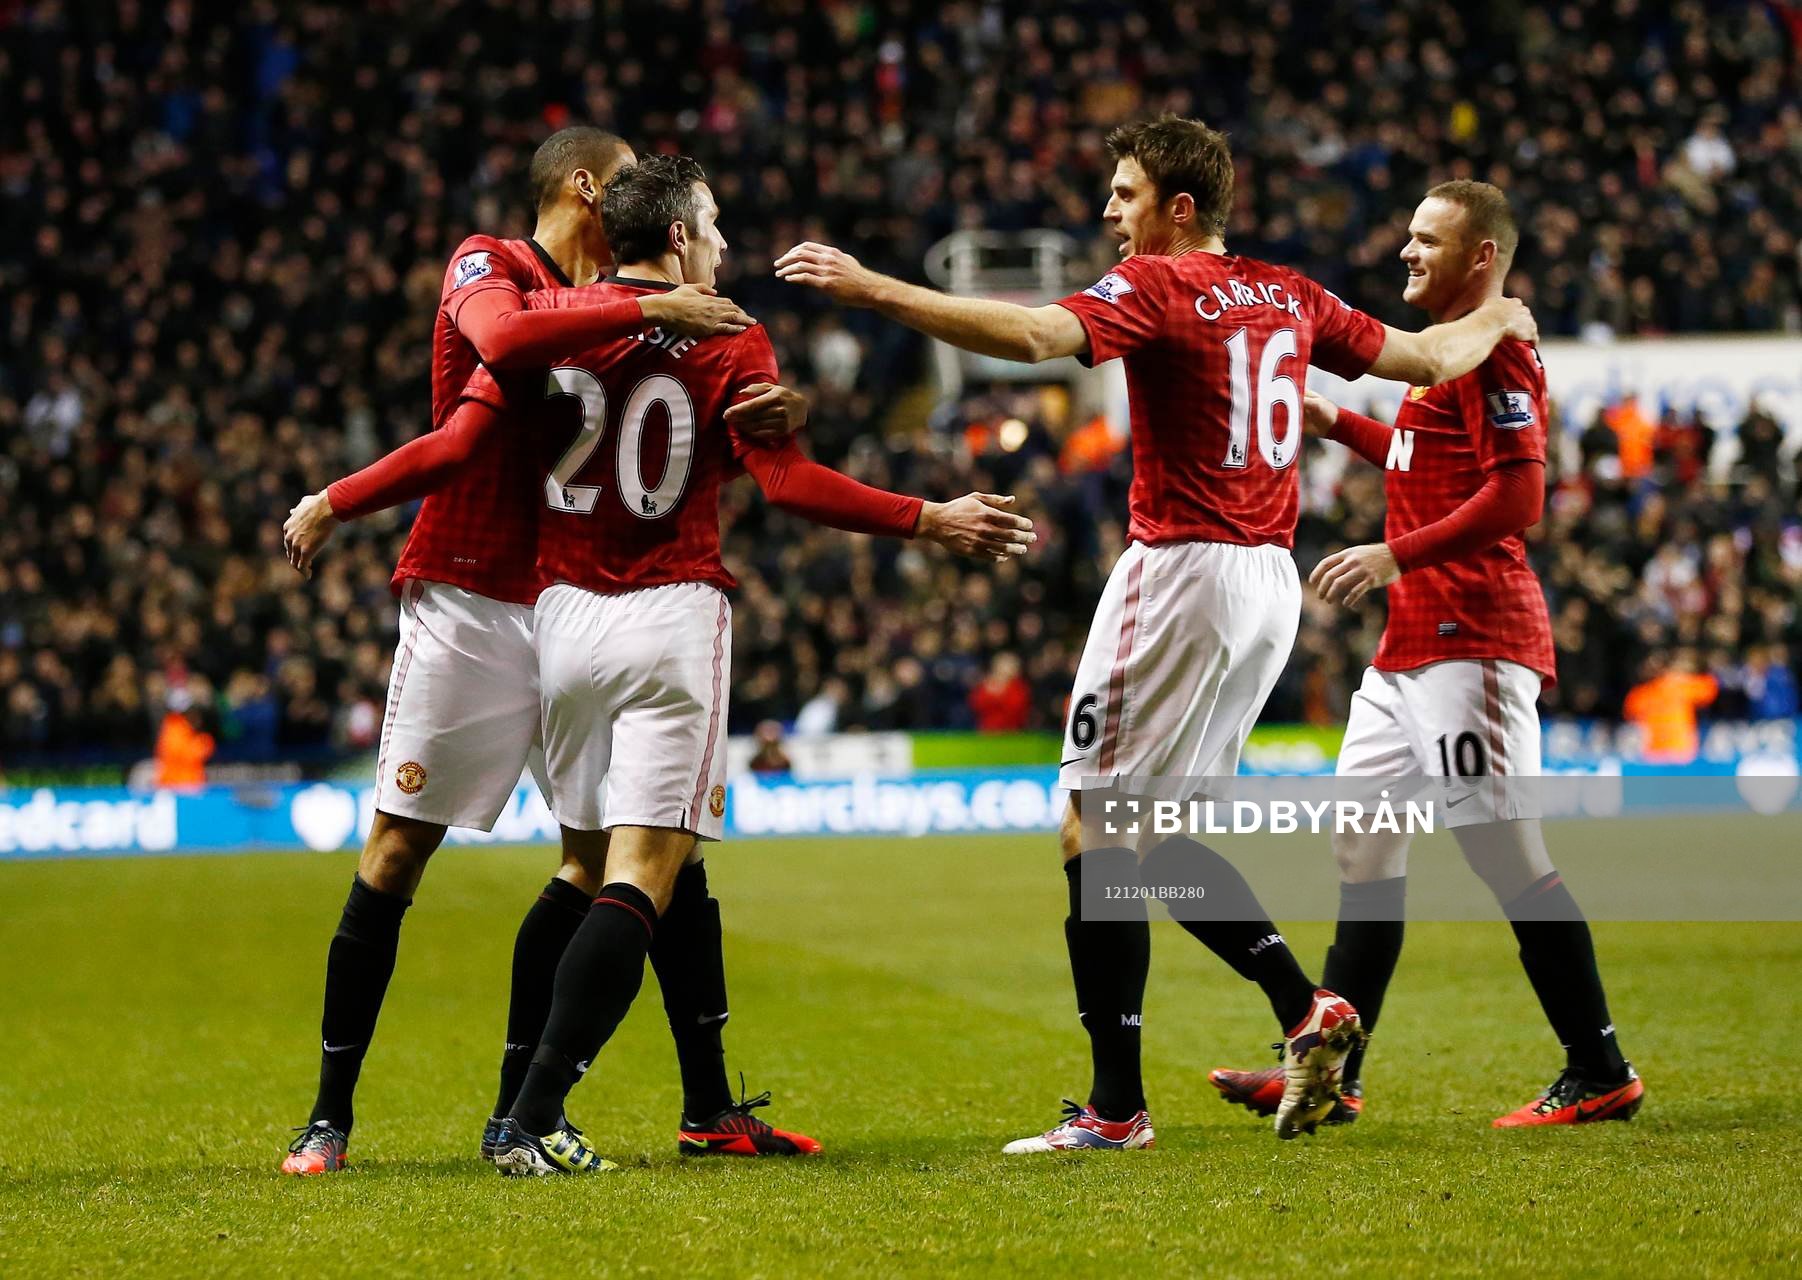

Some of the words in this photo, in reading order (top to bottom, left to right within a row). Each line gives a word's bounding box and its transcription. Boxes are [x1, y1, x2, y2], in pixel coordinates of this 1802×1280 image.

[1194, 279, 1303, 321] CARRICK
[627, 326, 698, 359] SIE
[1221, 326, 1303, 470] 16
[544, 366, 696, 519] 20
[1071, 693, 1098, 751] 6
[1436, 730, 1487, 788] 10
